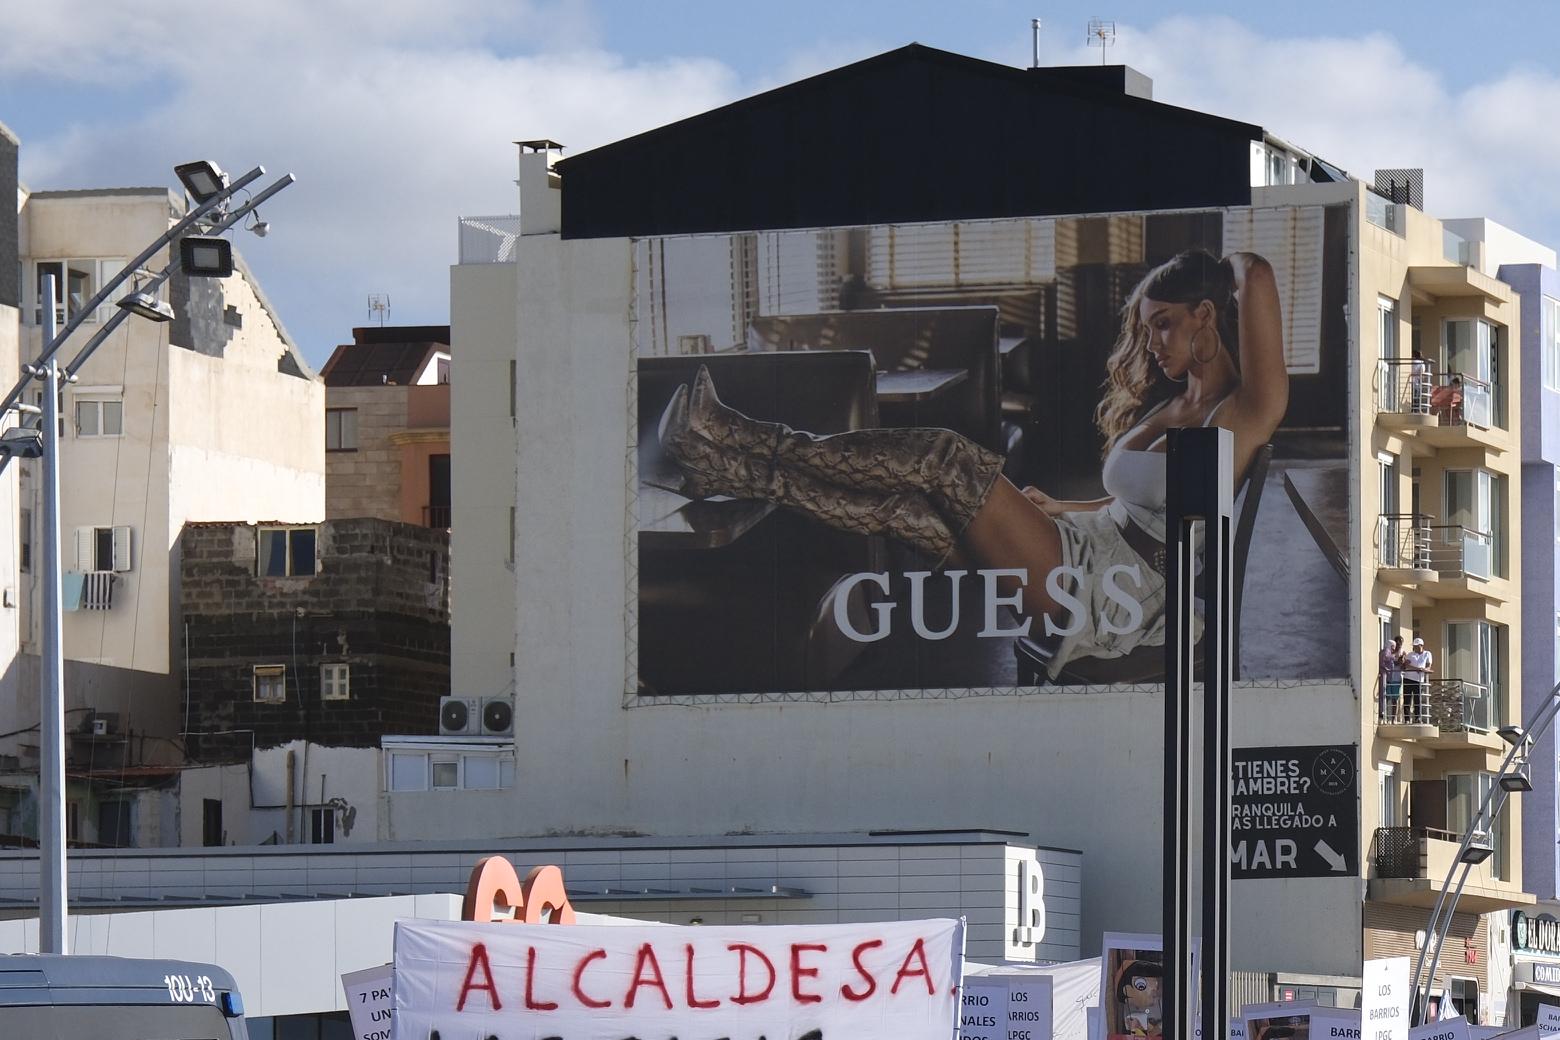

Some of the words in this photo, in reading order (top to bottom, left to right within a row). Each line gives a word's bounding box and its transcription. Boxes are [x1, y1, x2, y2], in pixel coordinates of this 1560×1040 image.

[832, 563, 1144, 643] GUESS
[1232, 802, 1305, 818] RANQUILA
[1233, 816, 1251, 830] AS
[1256, 814, 1324, 829] LLEGADO
[1328, 814, 1337, 827] A
[1527, 918, 1538, 949] EL
[1378, 984, 1392, 996] LOS
[961, 996, 989, 1007] RRIO
[1011, 992, 1028, 1002] LOS
[1008, 1011, 1040, 1022] RRIOS
[1369, 1006, 1400, 1021] BARRIOS
[960, 1016, 996, 1027] NALES
[1008, 1030, 1031, 1040] LPGC
[1330, 1027, 1361, 1039] BARR
